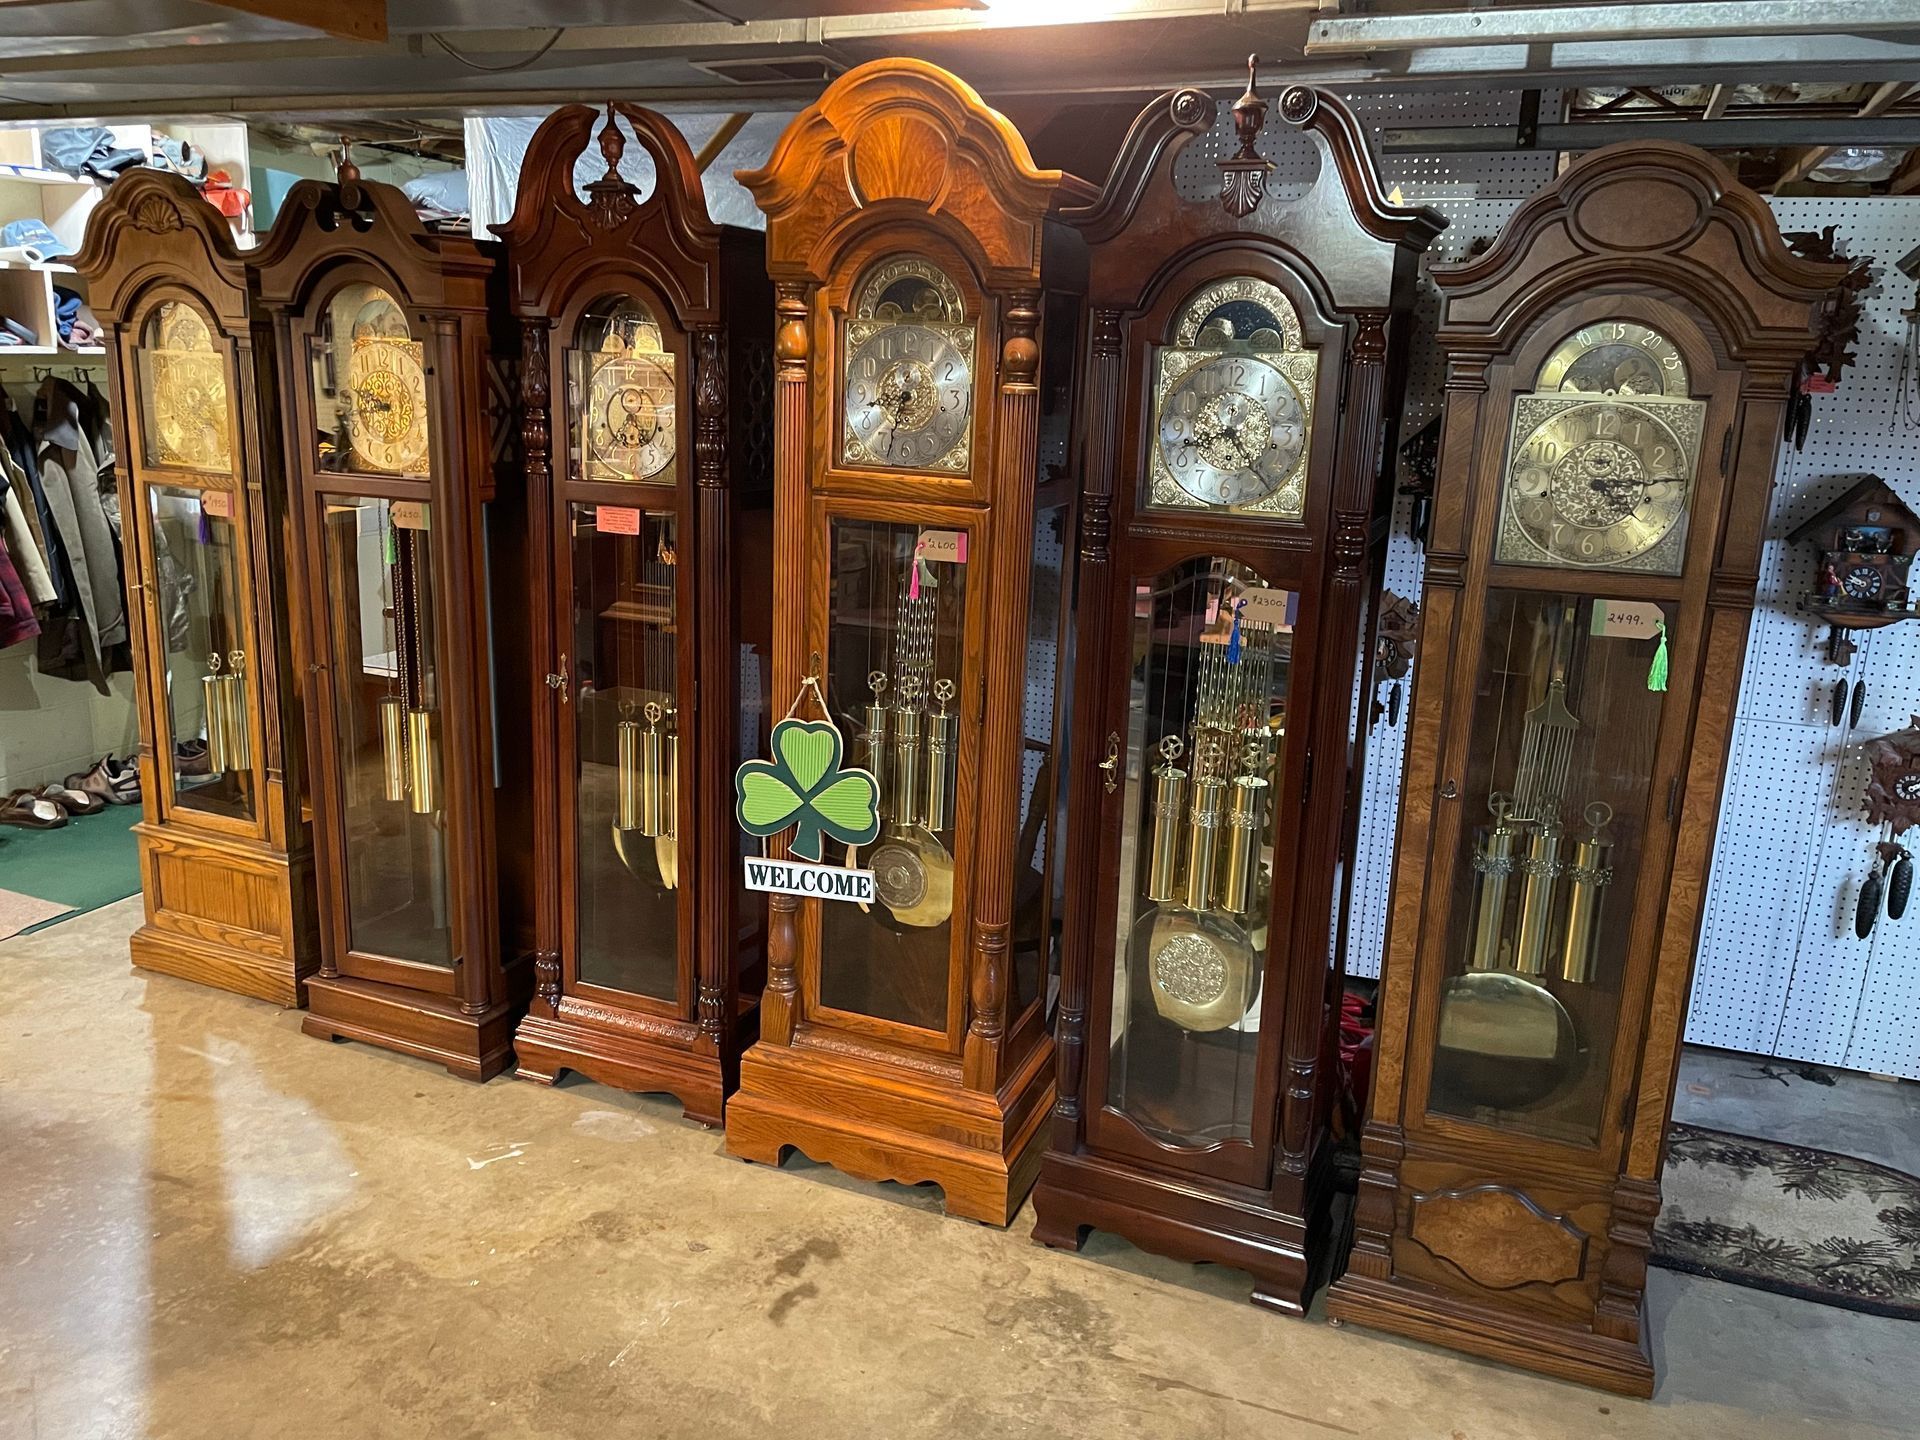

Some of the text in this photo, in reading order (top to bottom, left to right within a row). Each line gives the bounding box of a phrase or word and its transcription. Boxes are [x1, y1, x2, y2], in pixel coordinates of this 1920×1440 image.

[1576, 330, 1592, 348] 10
[1612, 323, 1626, 339] 15
[1641, 331, 1662, 350] 20
[881, 338, 891, 360] 11
[863, 357, 876, 378] 10
[944, 362, 954, 381] 2
[1663, 352, 1682, 370] 25
[625, 364, 636, 381] 12
[1229, 365, 1245, 387] 12
[412, 375, 420, 393] 2
[857, 386, 866, 403] 9
[1260, 374, 1266, 396] 1
[658, 388, 666, 403] 2
[950, 390, 960, 410] 3
[1276, 396, 1287, 419] 2
[862, 410, 872, 430] 8
[1173, 419, 1184, 440] 9
[1595, 413, 1615, 436] 12
[595, 429, 604, 446] 8
[1281, 425, 1292, 446] 3
[1564, 420, 1580, 443] 11
[1633, 421, 1641, 445] 1
[385, 445, 393, 464] 6
[648, 450, 655, 465] 5
[901, 439, 911, 457] 6
[1176, 446, 1188, 468] 8
[1536, 441, 1556, 465] 10
[1653, 446, 1666, 470] 2
[1196, 469, 1207, 489] 7
[1219, 477, 1230, 498] 6
[1526, 469, 1539, 493] 9
[1530, 500, 1544, 522] 8
[1552, 523, 1566, 544] 7
[1581, 533, 1594, 555] 6
[1617, 525, 1629, 546] 5
[1608, 613, 1644, 625] 2499.
[748, 863, 871, 898] WELCOME
